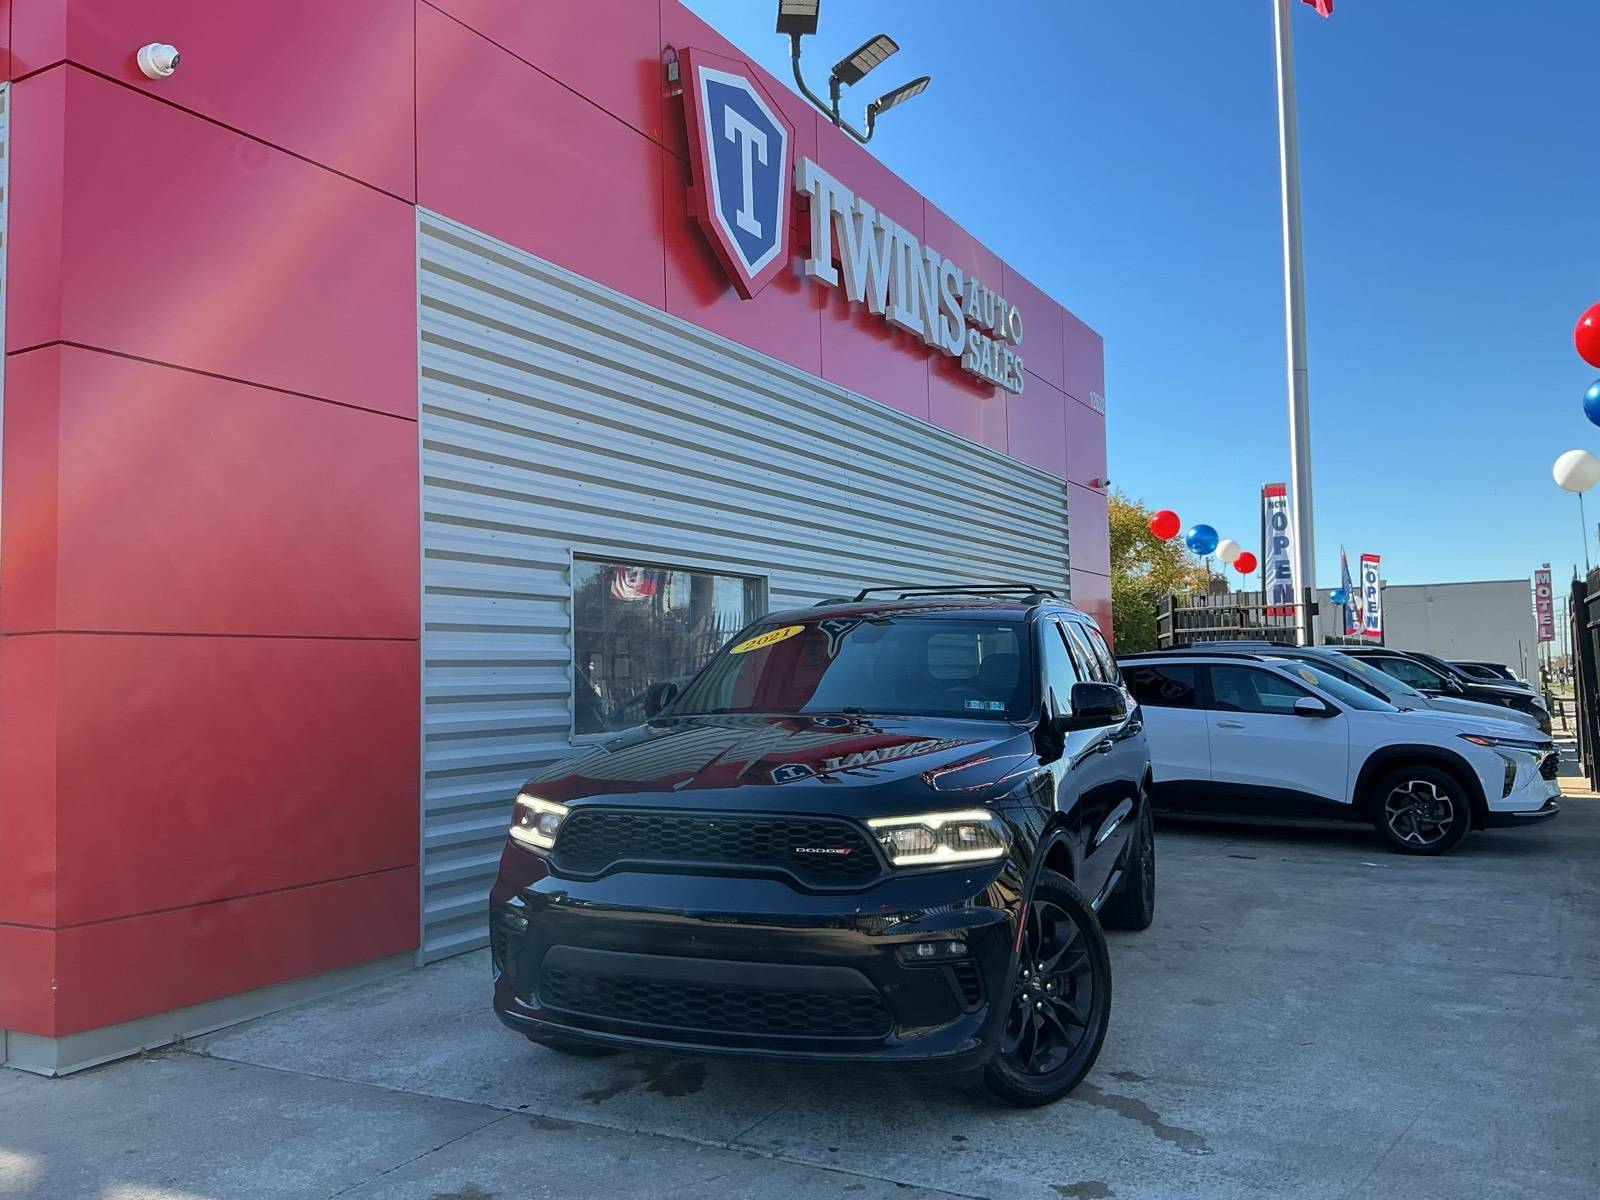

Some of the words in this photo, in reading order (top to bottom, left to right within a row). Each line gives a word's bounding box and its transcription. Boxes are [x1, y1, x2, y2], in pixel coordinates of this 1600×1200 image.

[725, 104, 768, 239] T
[796, 156, 966, 356] TWINS
[964, 276, 1023, 345] AUTO
[962, 328, 1024, 394] SALES
[1268, 500, 1287, 509] NOW
[1271, 511, 1294, 604] OPEN
[1365, 571, 1379, 629] OPEN
[1536, 573, 1551, 638] MOTEL
[745, 628, 792, 650] 2021
